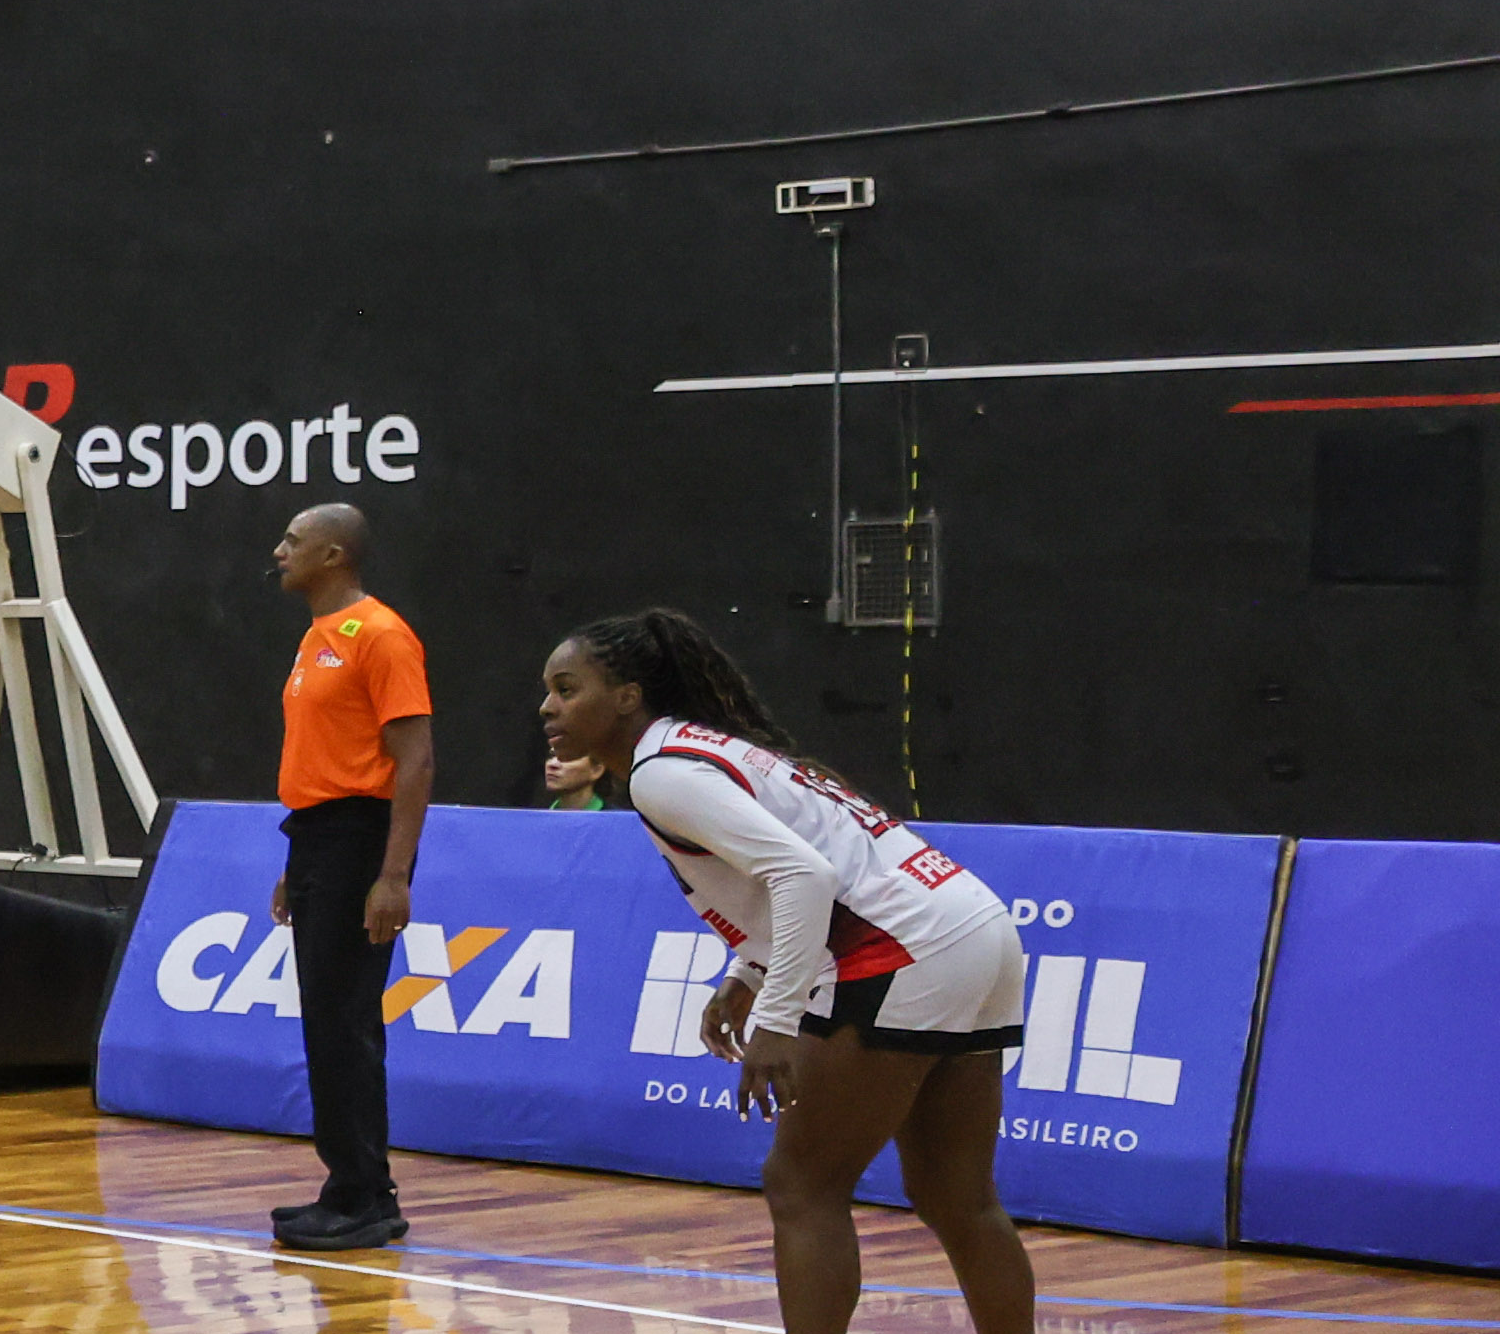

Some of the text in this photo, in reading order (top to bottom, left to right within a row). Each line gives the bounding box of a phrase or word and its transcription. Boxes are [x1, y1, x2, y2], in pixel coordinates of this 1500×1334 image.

[76, 402, 420, 511] esporte
[1011, 898, 1075, 928] DO
[156, 911, 575, 1039] CAXA
[630, 930, 1182, 1106] BIL
[644, 1080, 688, 1104] DO
[699, 1086, 779, 1114] LA
